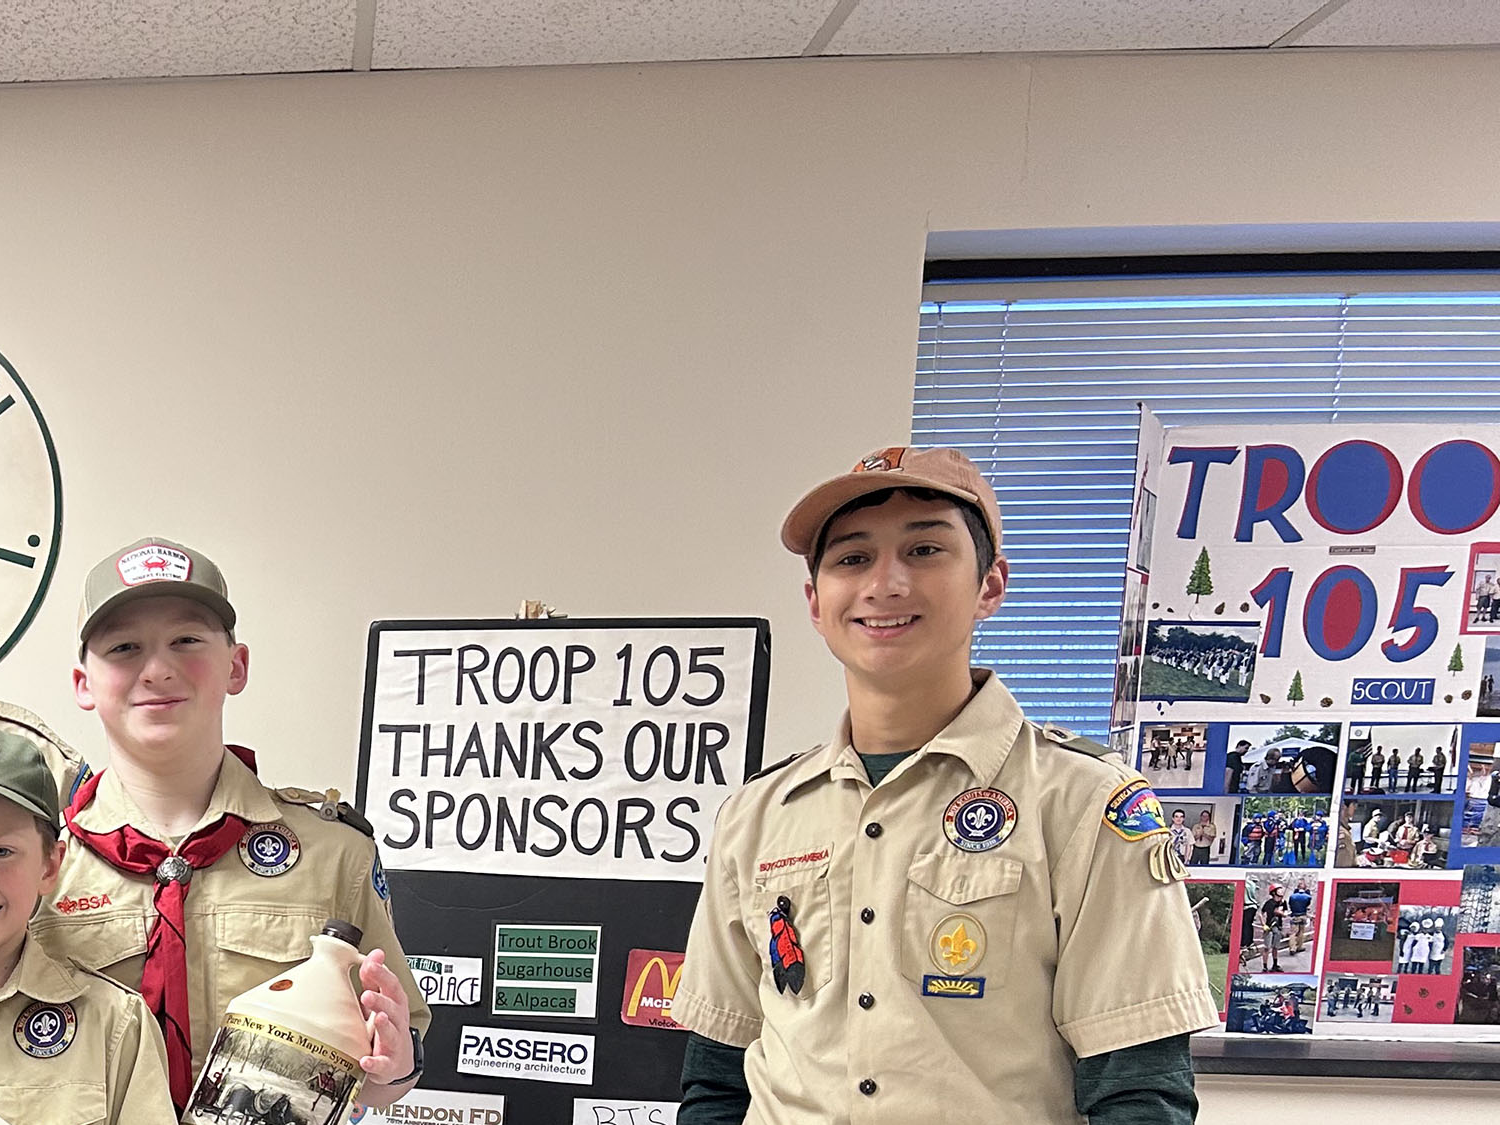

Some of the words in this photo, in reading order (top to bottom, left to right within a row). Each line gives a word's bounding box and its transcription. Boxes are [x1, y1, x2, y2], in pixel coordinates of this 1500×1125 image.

[1250, 564, 1456, 663] 105
[393, 643, 597, 706] TROOP
[612, 642, 726, 707] 105
[1353, 680, 1431, 700] SCOUT
[378, 720, 604, 782] THANKS
[623, 719, 731, 786] OUR
[78, 893, 112, 912] BSA
[499, 933, 543, 950] Trout
[548, 934, 598, 951] Brook
[497, 961, 594, 980] Sugarhouse
[495, 991, 509, 1007] &
[512, 992, 577, 1011] Alpacas
[226, 1014, 242, 1026] Pure
[243, 1017, 265, 1031] New
[266, 1023, 295, 1043] York
[295, 1034, 329, 1059] Maple
[328, 1050, 355, 1072] Syrup
[462, 1034, 589, 1065] PASSERO
[461, 1057, 522, 1072] engineering
[523, 1062, 587, 1076] architecture
[372, 1104, 464, 1123] MENDON
[468, 1108, 501, 1125] FD
